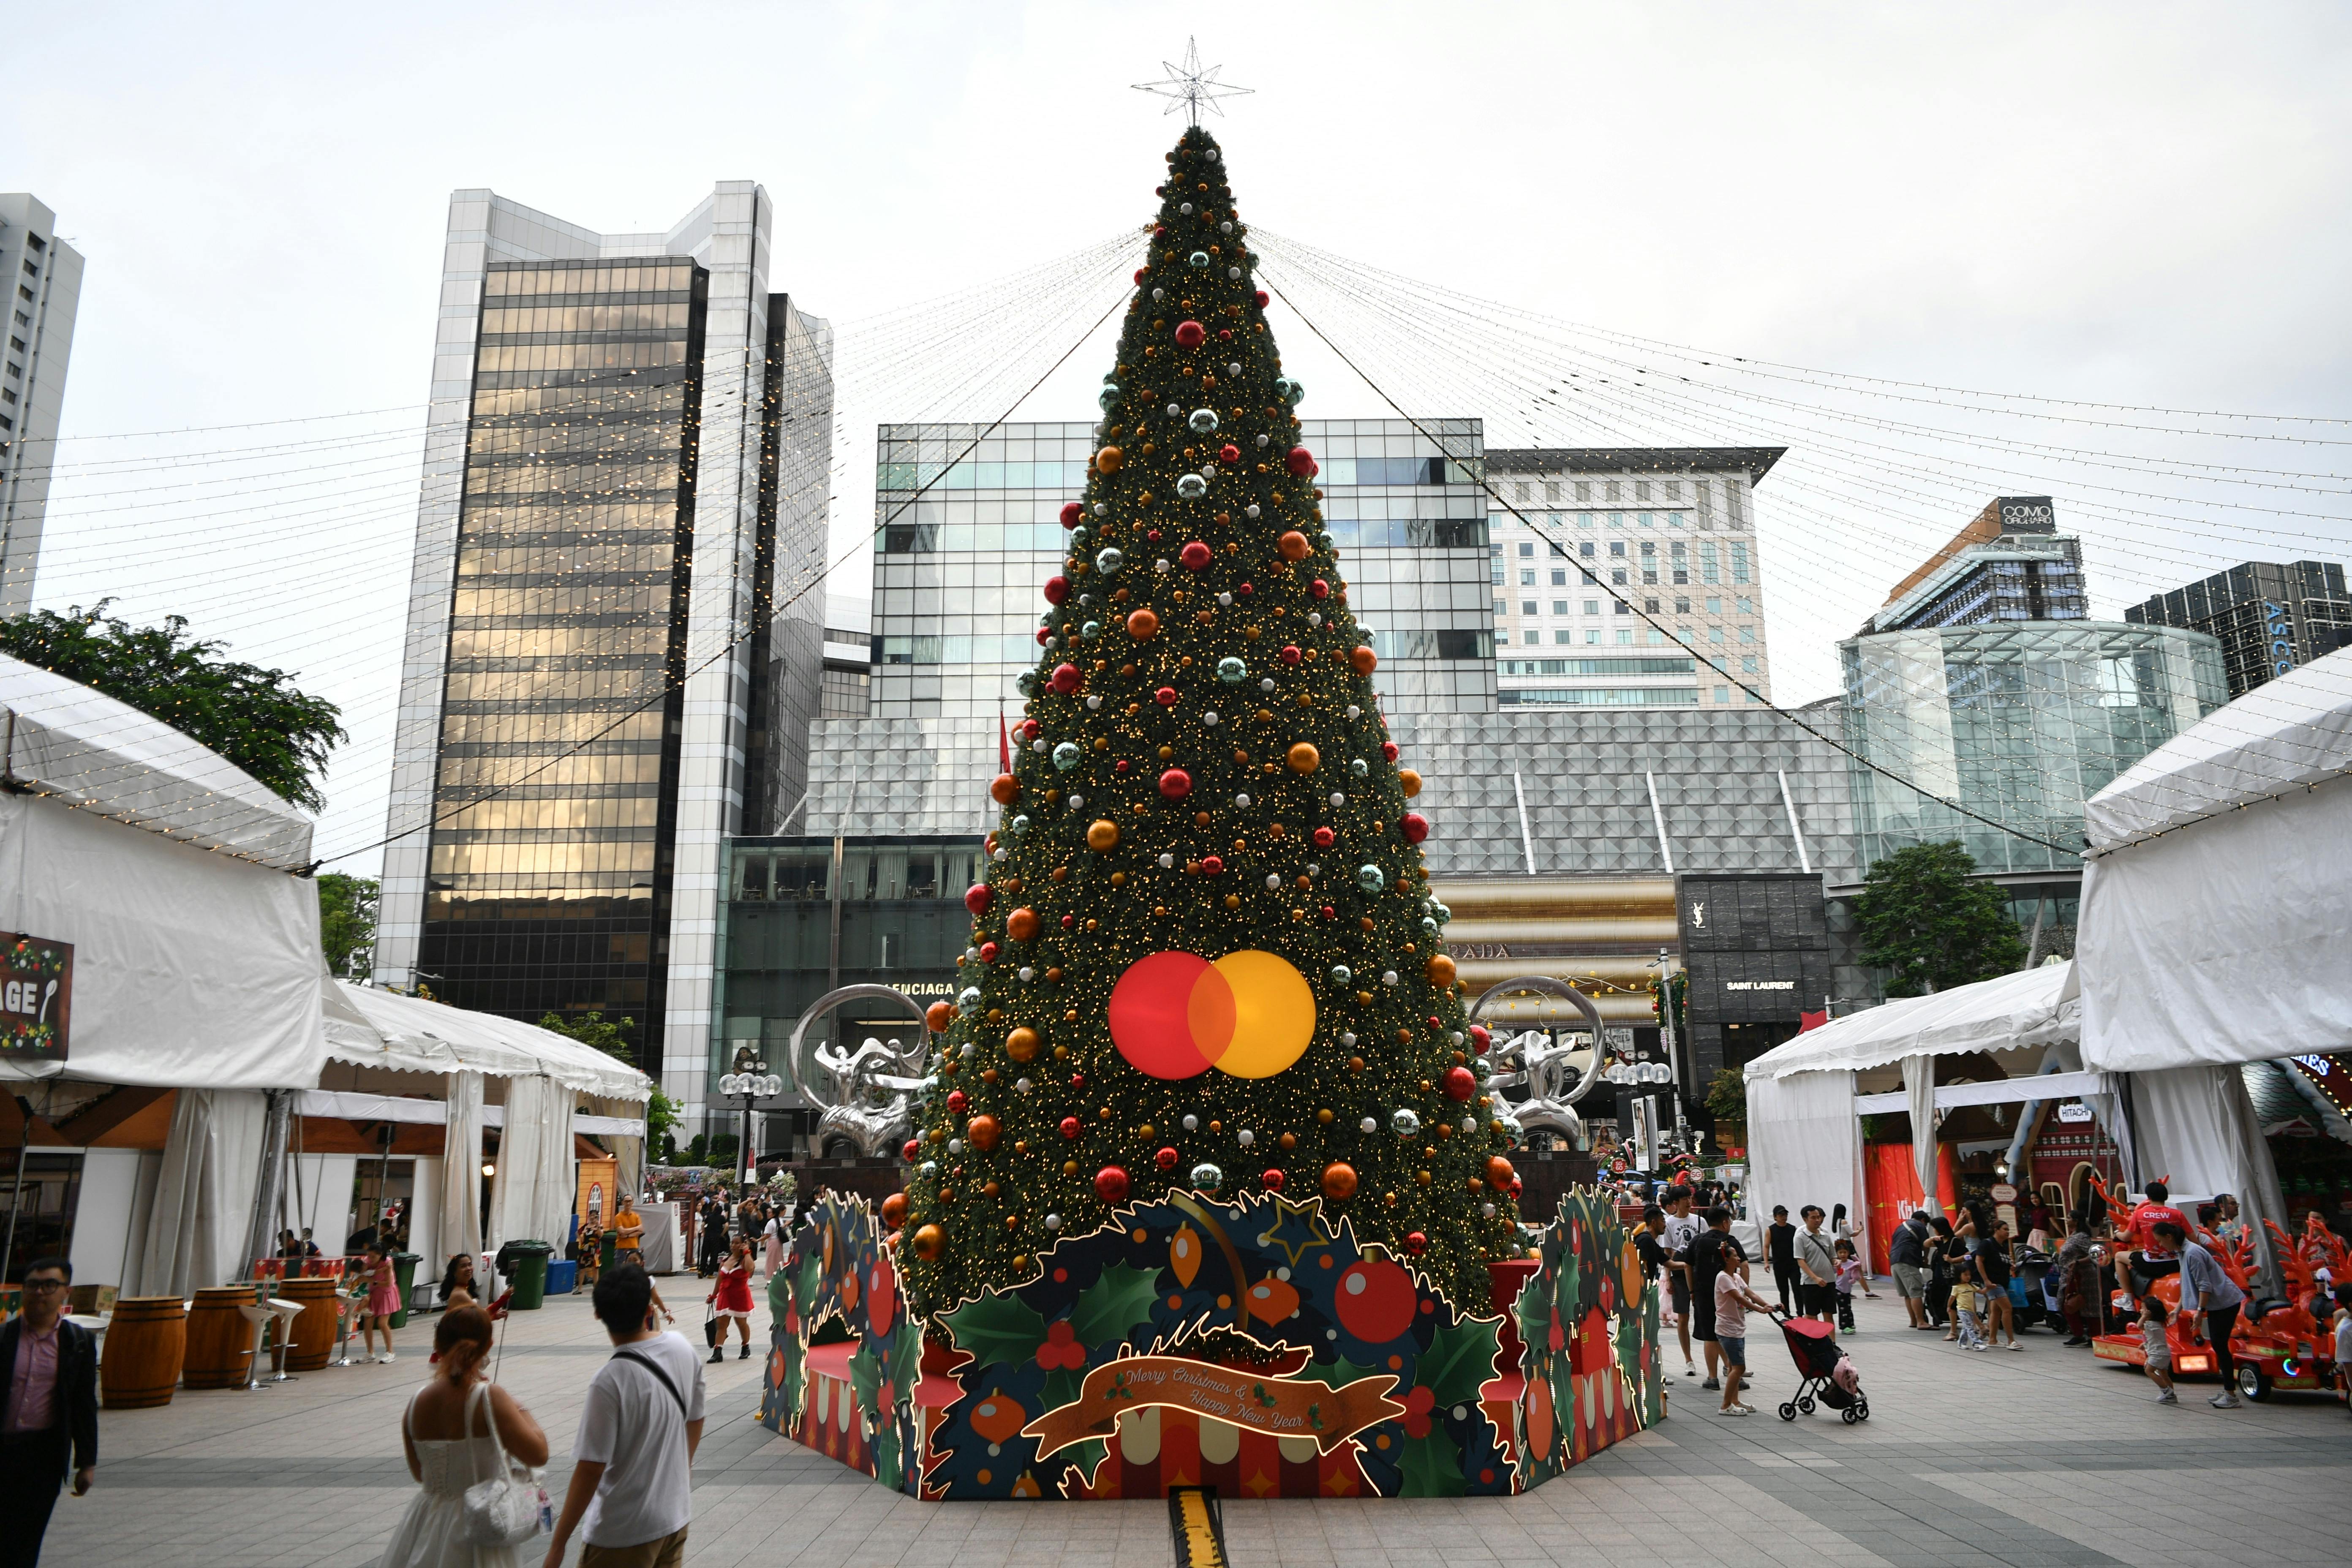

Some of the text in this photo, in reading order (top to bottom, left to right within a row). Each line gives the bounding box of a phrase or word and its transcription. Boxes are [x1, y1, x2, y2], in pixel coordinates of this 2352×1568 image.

[2003, 506, 2051, 517] COMO
[1447, 944, 1514, 958] RADA
[885, 983, 954, 995] ENCIAGA
[1727, 982, 1794, 990] SAINT LAURENT
[0, 979, 37, 1014] GE
[2062, 1108, 2089, 1117] HITACHI
[1677, 1224, 1699, 1234] BATHING
[1127, 1368, 1247, 1400] Merry Christmas &
[1190, 1389, 1304, 1428] Happy New Year
